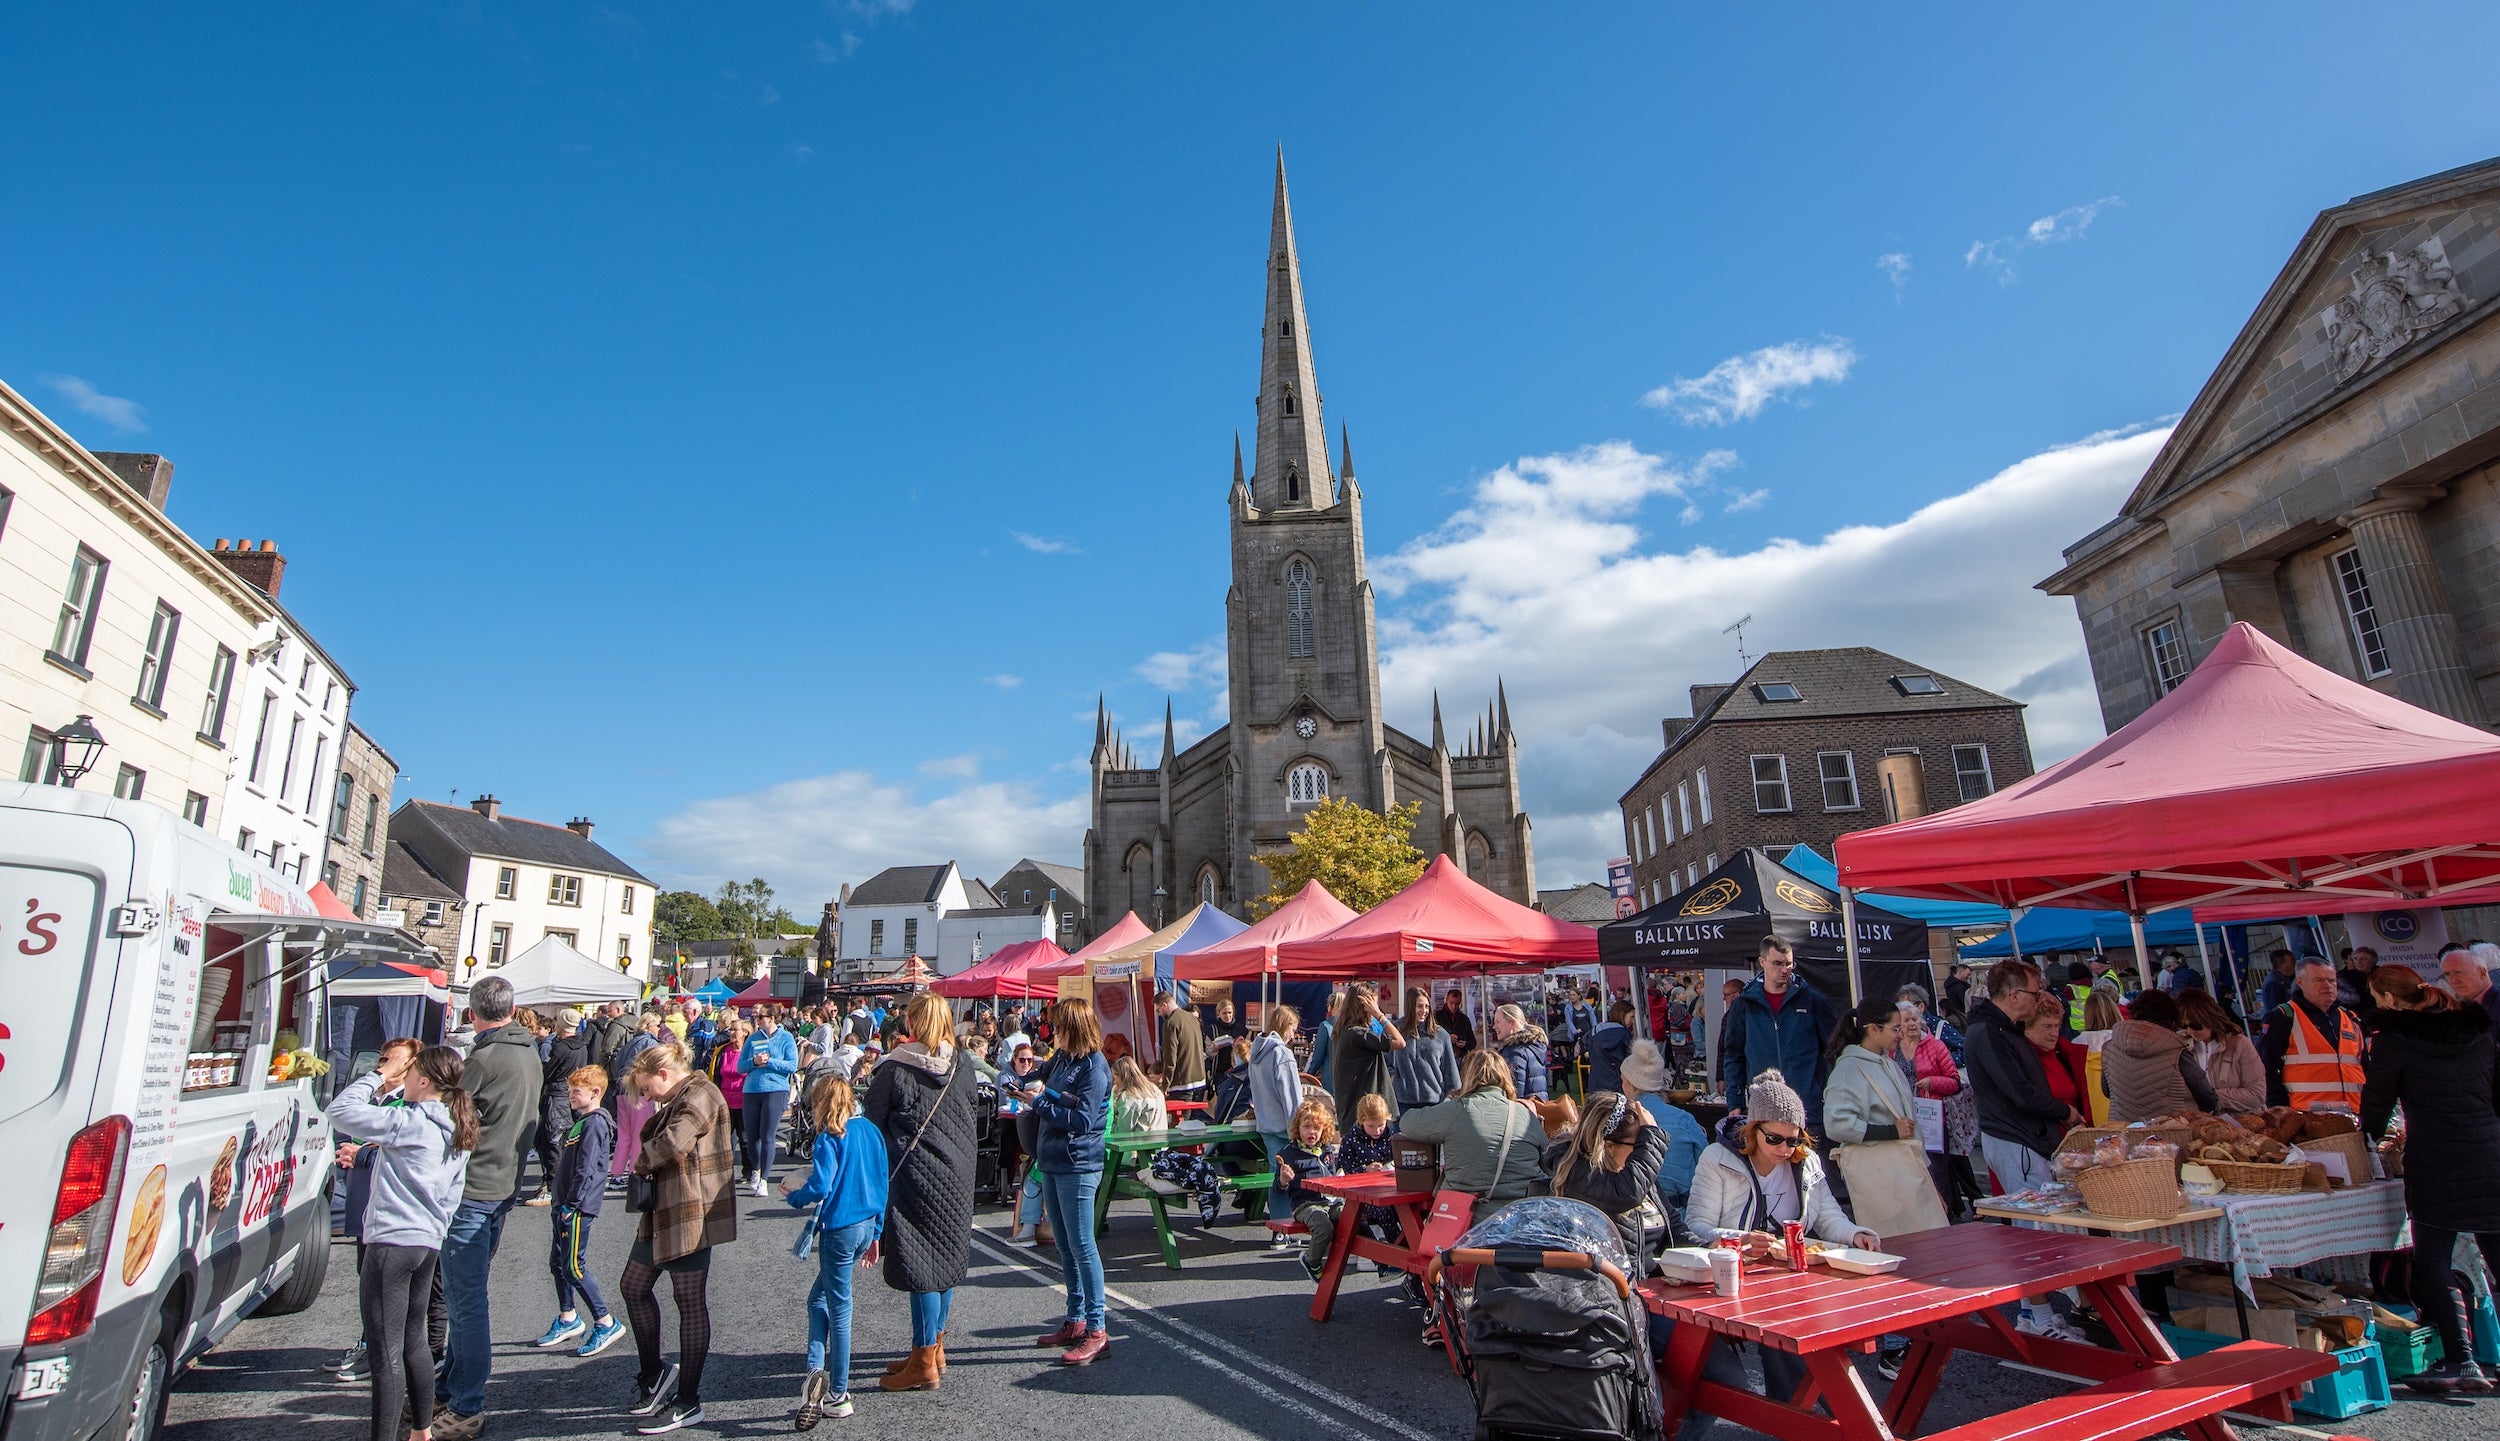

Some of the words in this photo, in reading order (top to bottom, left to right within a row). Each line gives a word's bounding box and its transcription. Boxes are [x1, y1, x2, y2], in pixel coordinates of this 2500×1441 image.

[1615, 867, 1626, 877] TAXI
[228, 858, 252, 902] Sweet
[1611, 876, 1631, 887] PARKING
[1616, 886, 1628, 896] ONLY
[1635, 924, 1725, 945] BALLYLISK
[1809, 920, 1893, 941] BALLLISK
[1671, 947, 1700, 956] ARMAGH
[1836, 945, 1845, 953] OF
[2389, 945, 2414, 953] IRISH
[1191, 985, 1230, 995] Butternut
